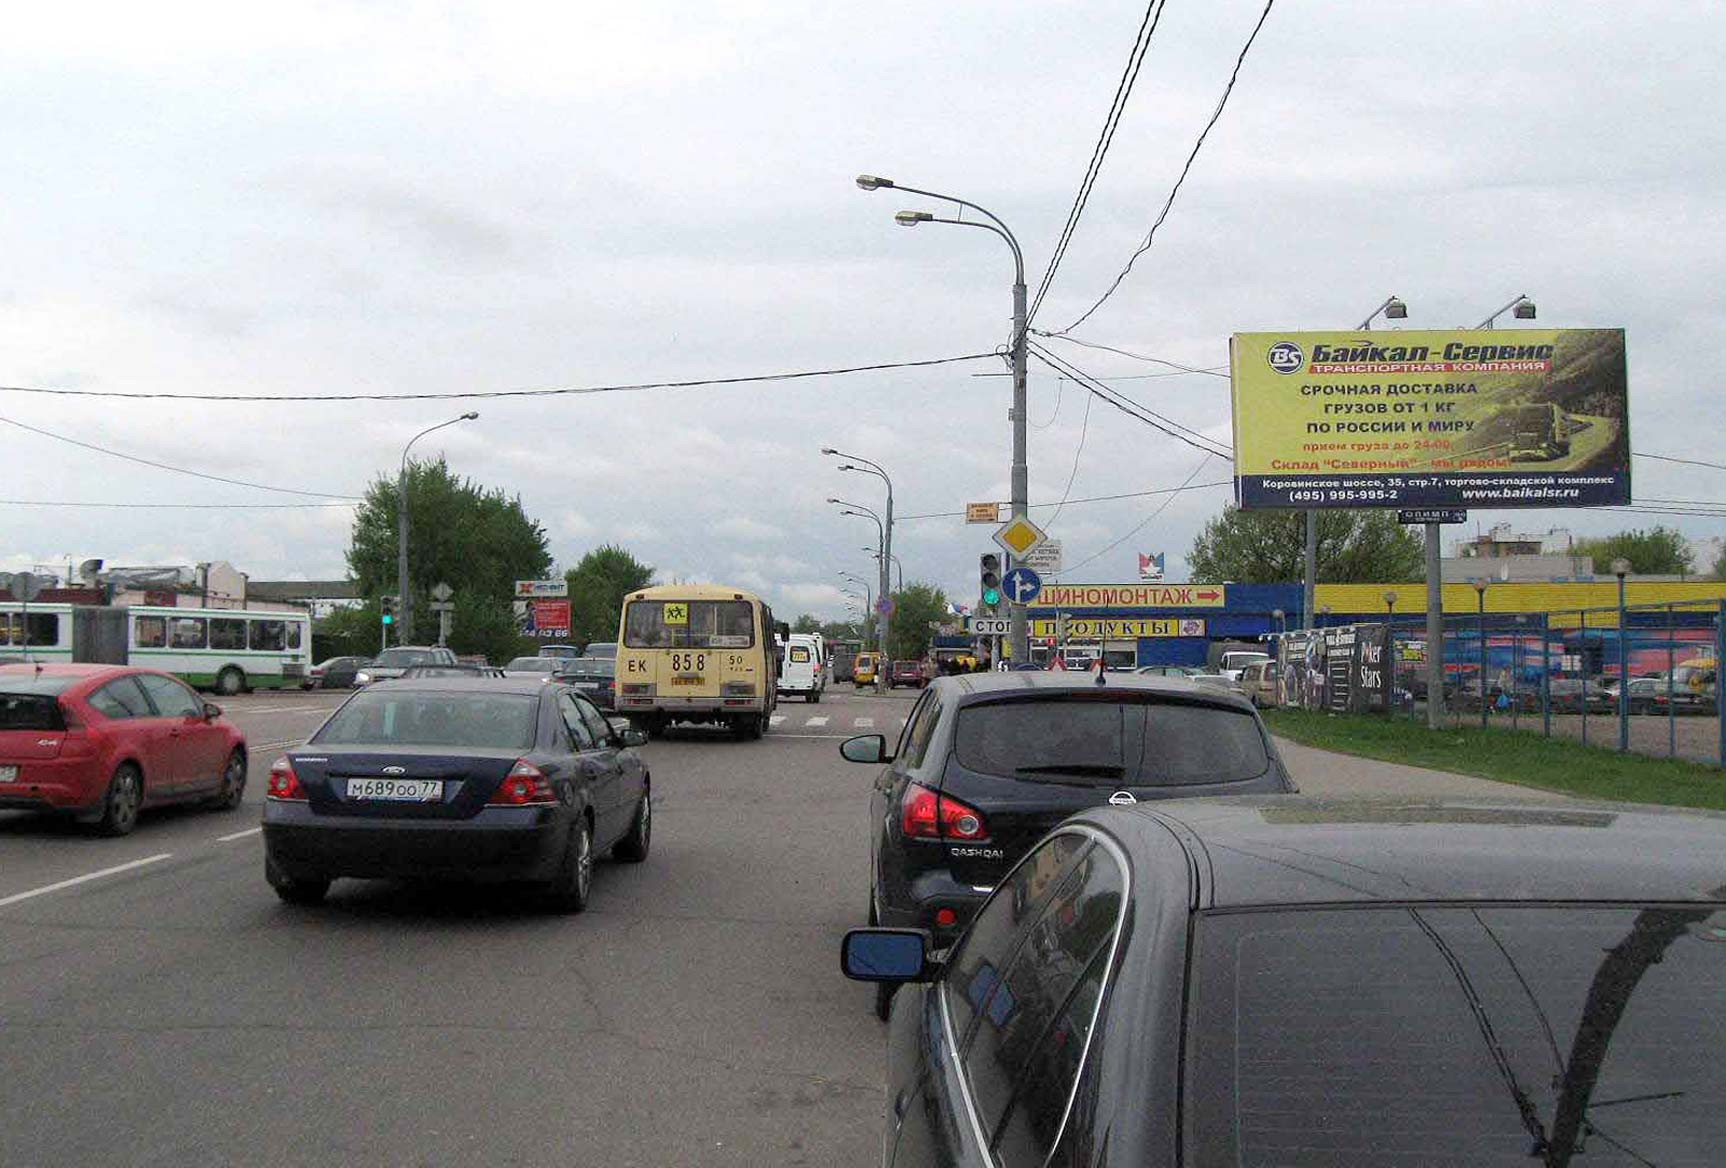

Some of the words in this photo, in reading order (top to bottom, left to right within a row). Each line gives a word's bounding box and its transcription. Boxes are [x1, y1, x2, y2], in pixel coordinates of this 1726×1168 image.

[1269, 347, 1303, 367] BS
[1311, 343, 1553, 364] Байкал-Сервис
[1313, 363, 1445, 373] ТРАНСПОРТНАЯ
[1452, 362, 1546, 372] КОМПАНИЯ
[1300, 385, 1381, 396] СРОЧНАЯ
[1386, 383, 1478, 396] ДОСТАВКА
[1323, 403, 1388, 414] ГРУЗОВ
[1393, 402, 1414, 413] ОТ
[1421, 402, 1428, 413] 1
[1436, 402, 1455, 413] КГ
[1306, 422, 1330, 433] ПО
[1336, 422, 1406, 433] РОССИИ
[1411, 421, 1422, 432] И
[1428, 420, 1475, 432] МИРУ
[1392, 441, 1409, 452] до
[1271, 459, 1320, 471] Склад
[1262, 479, 1340, 489] Коровинское
[1343, 479, 1385, 488] шоссе,
[1444, 476, 1555, 487] торгово-складской
[1557, 475, 1615, 485] комплекс
[1289, 490, 1325, 502] (495)
[1329, 489, 1398, 501] 995-995-2
[1462, 487, 1580, 499] www.baikalsr.ru
[1037, 587, 1192, 605] ШИНОМОНТАЖ
[1044, 621, 1169, 637] ПОДУКТЫ
[628, 659, 647, 672] ЕК
[672, 653, 705, 671] 858
[728, 655, 743, 665] 50
[1360, 665, 1382, 688] Stars
[951, 847, 1004, 858] QASHQAI
